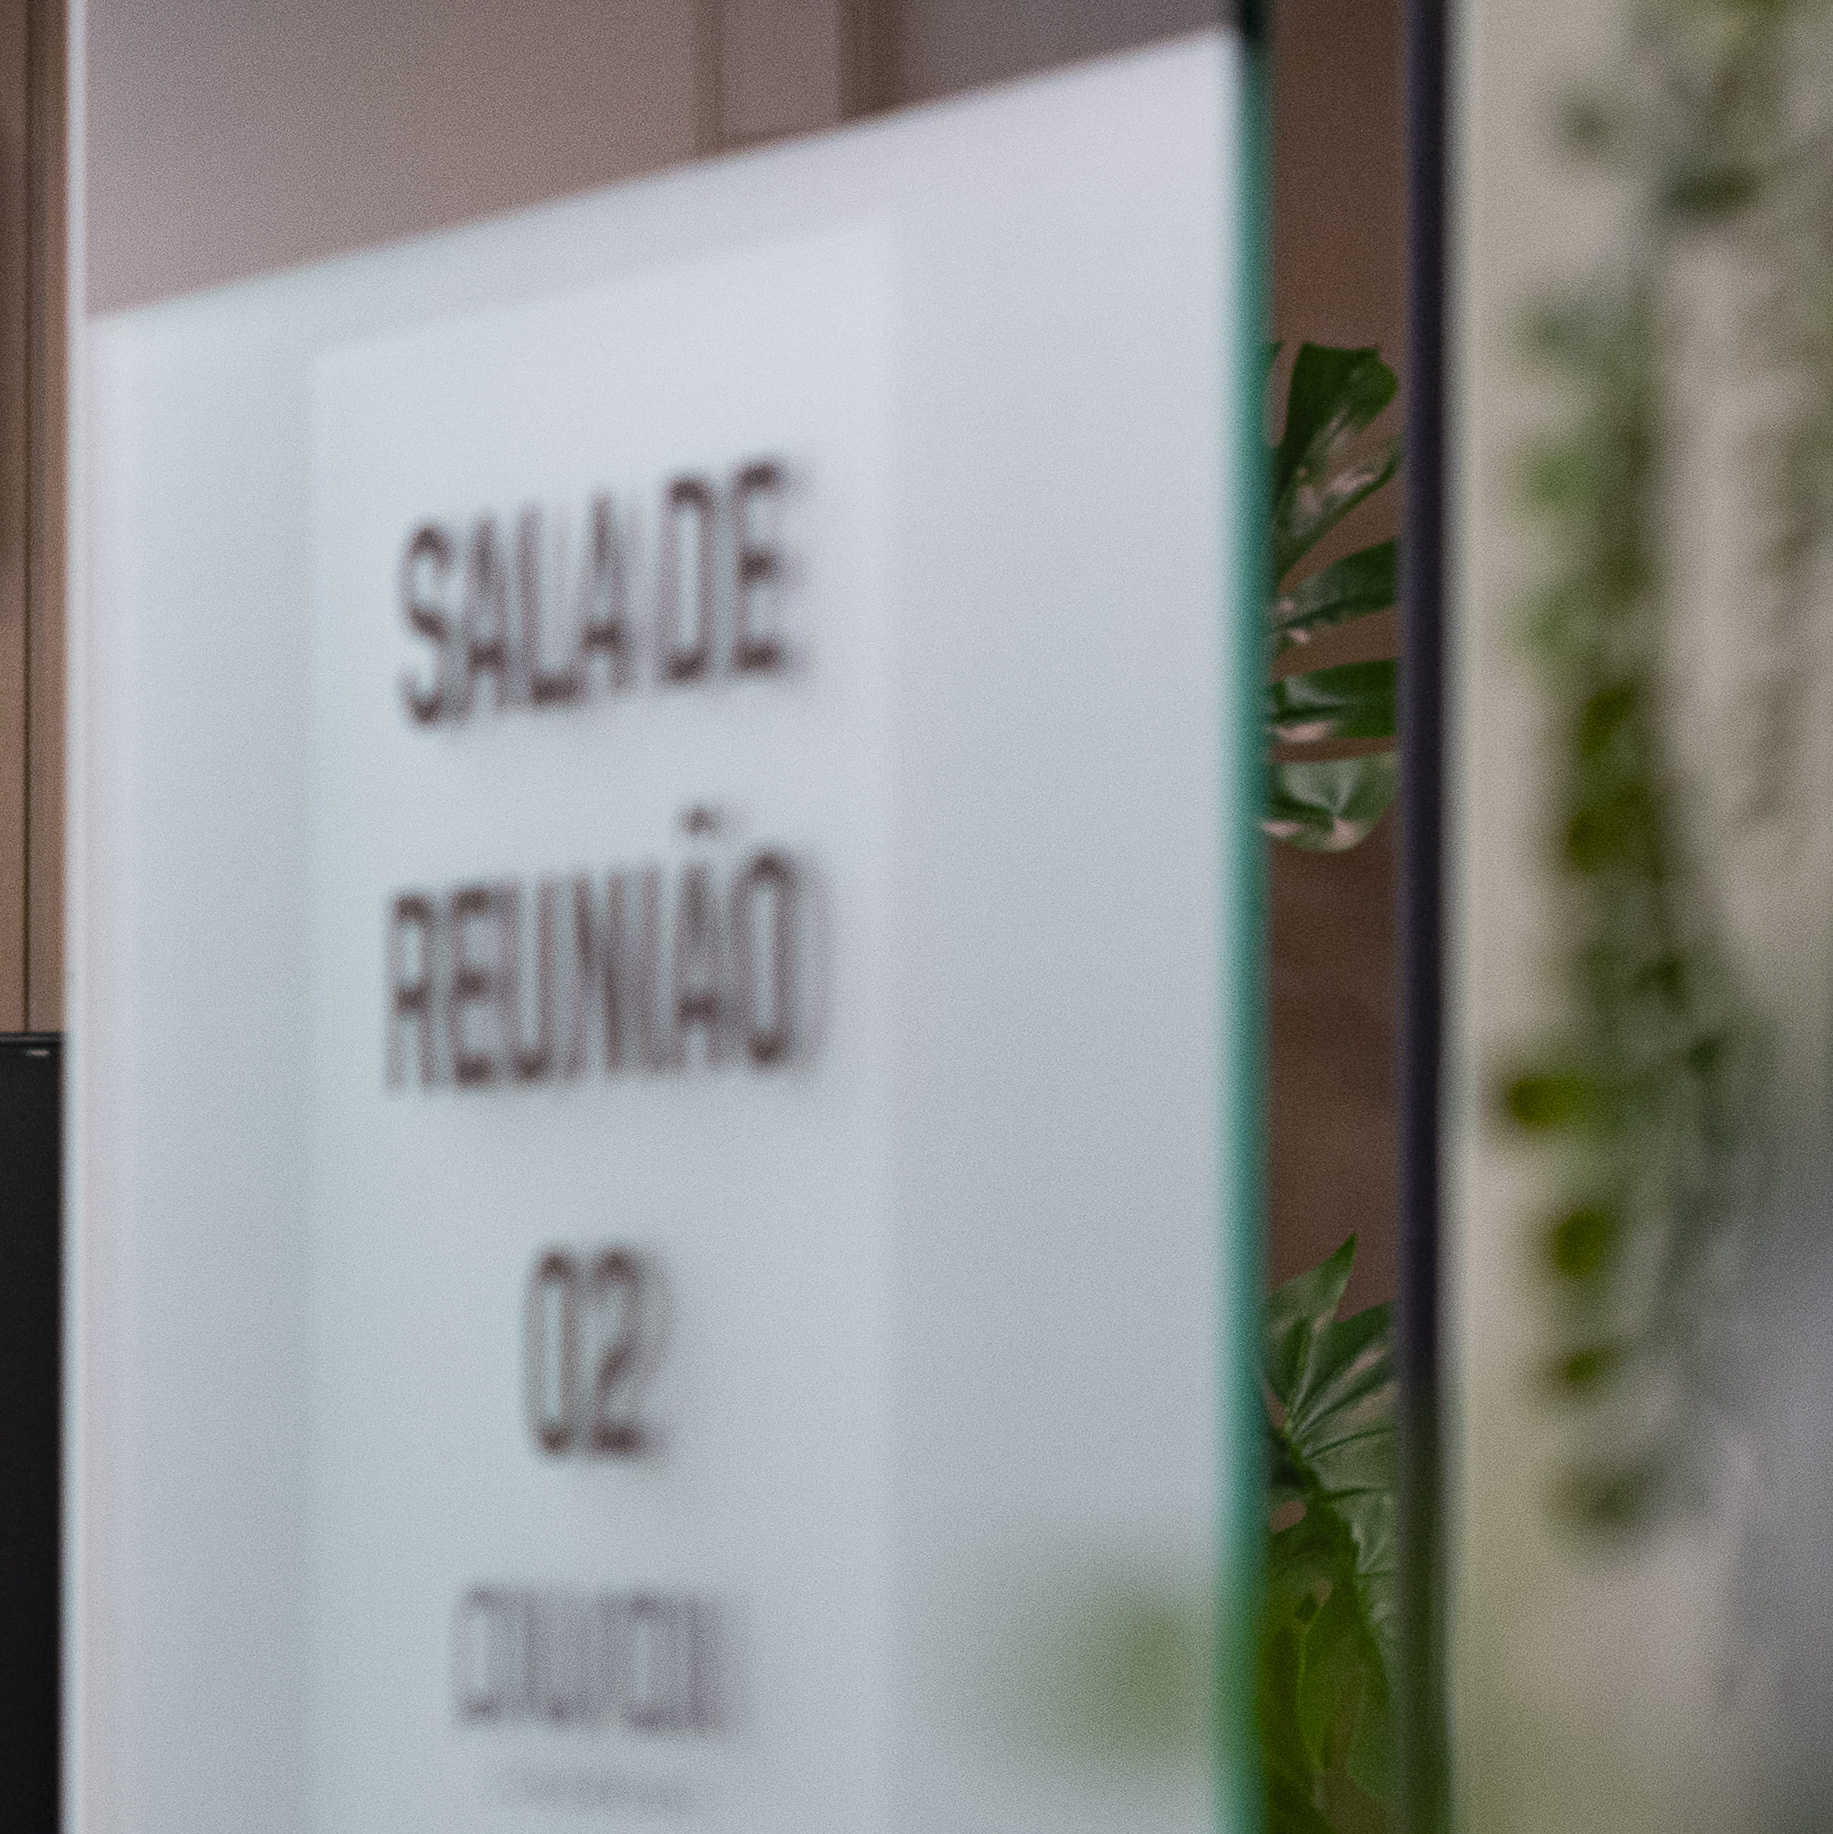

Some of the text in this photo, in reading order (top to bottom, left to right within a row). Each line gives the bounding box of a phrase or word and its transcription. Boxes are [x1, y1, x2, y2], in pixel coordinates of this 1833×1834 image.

[397, 456, 799, 726] SALA DE
[385, 802, 807, 1096] REUNIÃO
[525, 1246, 661, 1458] 02
